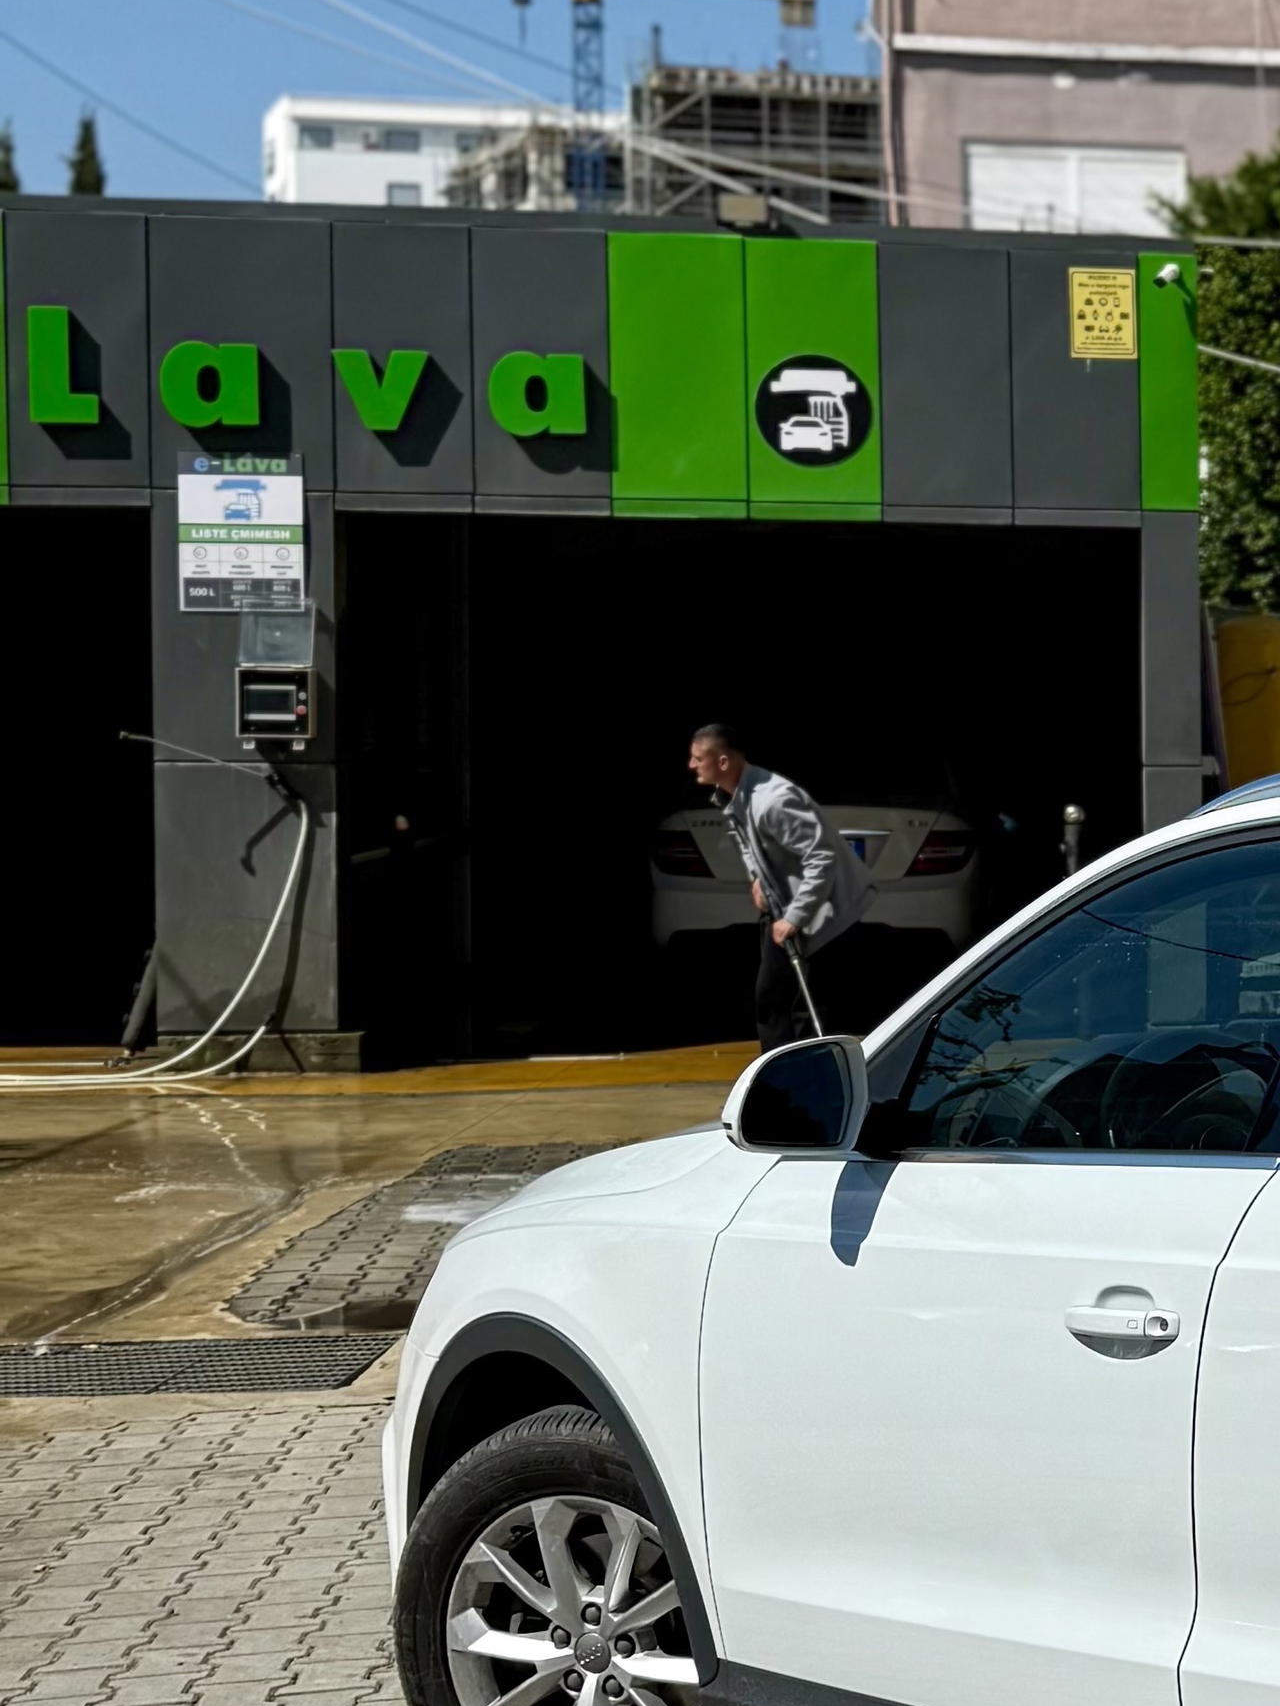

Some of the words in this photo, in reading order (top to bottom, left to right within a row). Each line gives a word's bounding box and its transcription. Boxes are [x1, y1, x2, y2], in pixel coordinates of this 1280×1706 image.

[28, 305, 587, 437] Lava
[193, 453, 287, 473] e-Lava
[192, 529, 228, 539] LISTE
[189, 587, 208, 597] 500
